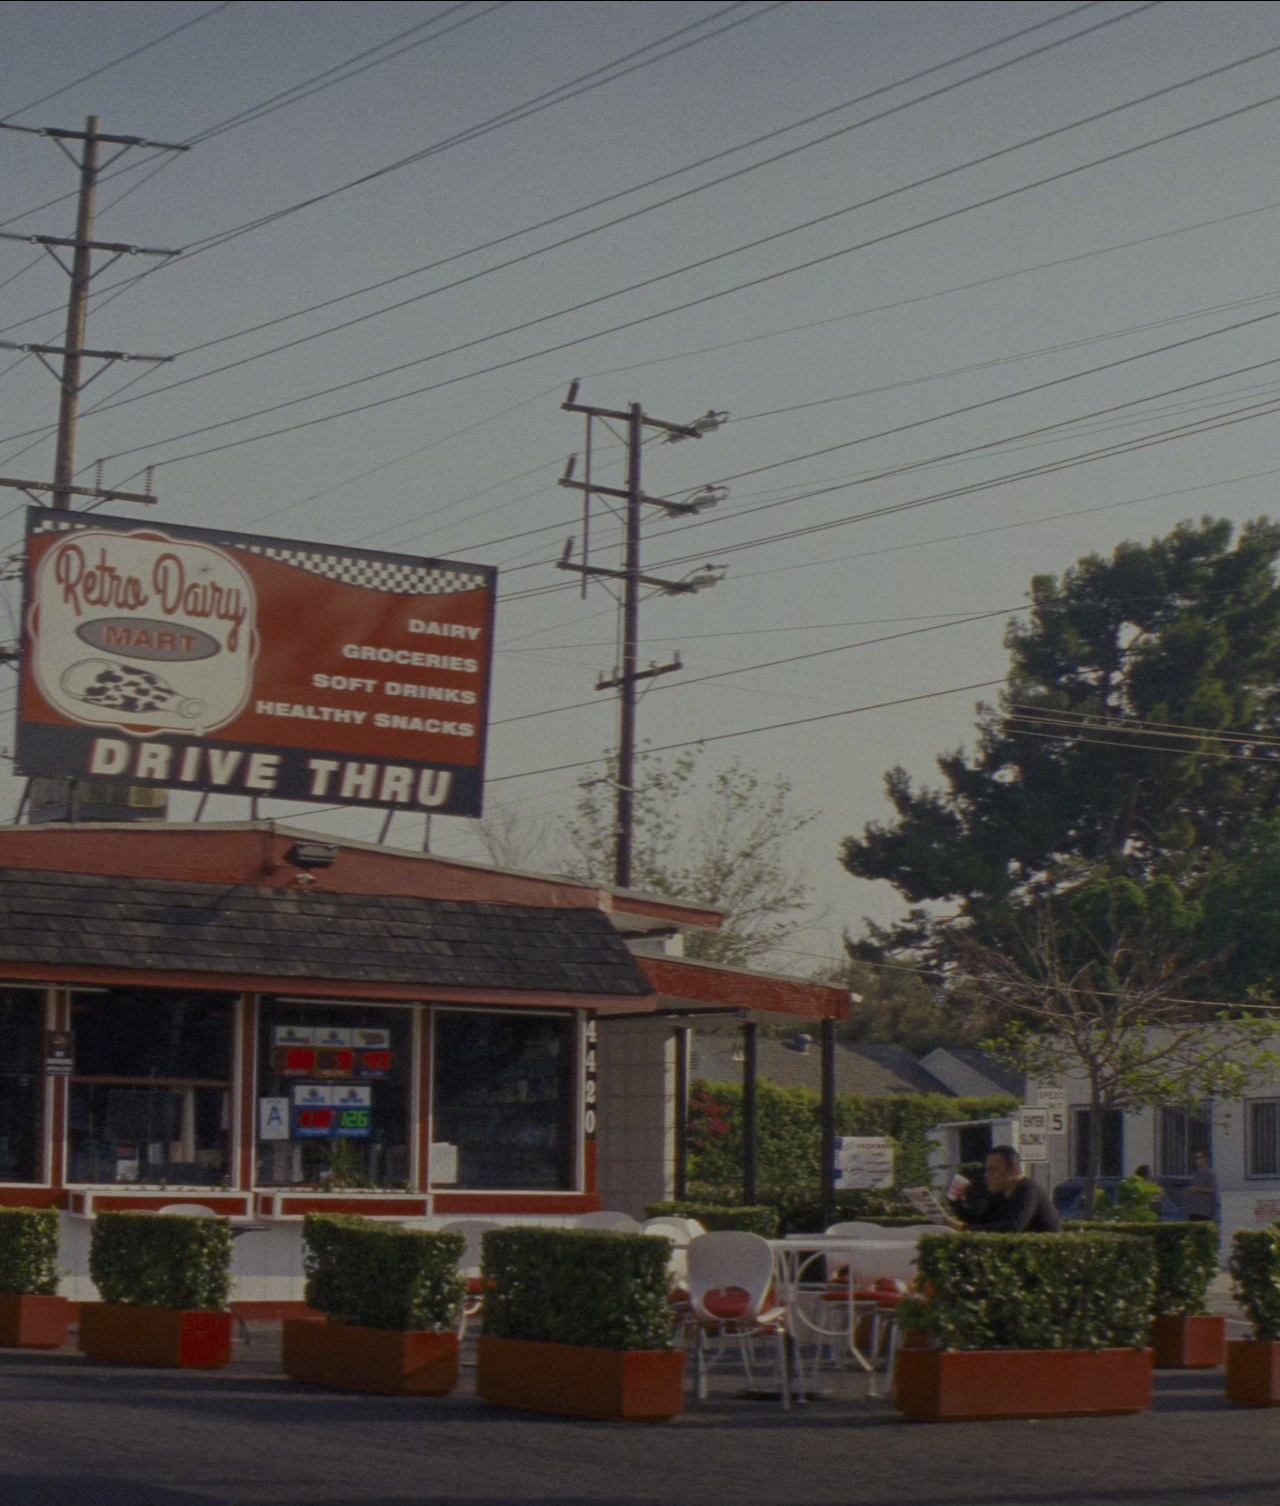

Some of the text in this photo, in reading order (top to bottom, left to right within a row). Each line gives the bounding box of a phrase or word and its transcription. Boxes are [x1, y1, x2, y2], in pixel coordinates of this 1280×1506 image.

[56, 543, 247, 653] Retro Dairy
[102, 625, 200, 653] MART
[408, 619, 481, 641] DAIRY
[342, 644, 479, 672] GROCERIES
[312, 673, 477, 705] SOFT DRINKS
[255, 700, 475, 738] HEALTHY SNACKS
[89, 738, 453, 807] DRIVE THRU
[267, 1105, 283, 1125] A
[341, 1109, 369, 1128] 126
[1052, 1113, 1063, 1131] 5
